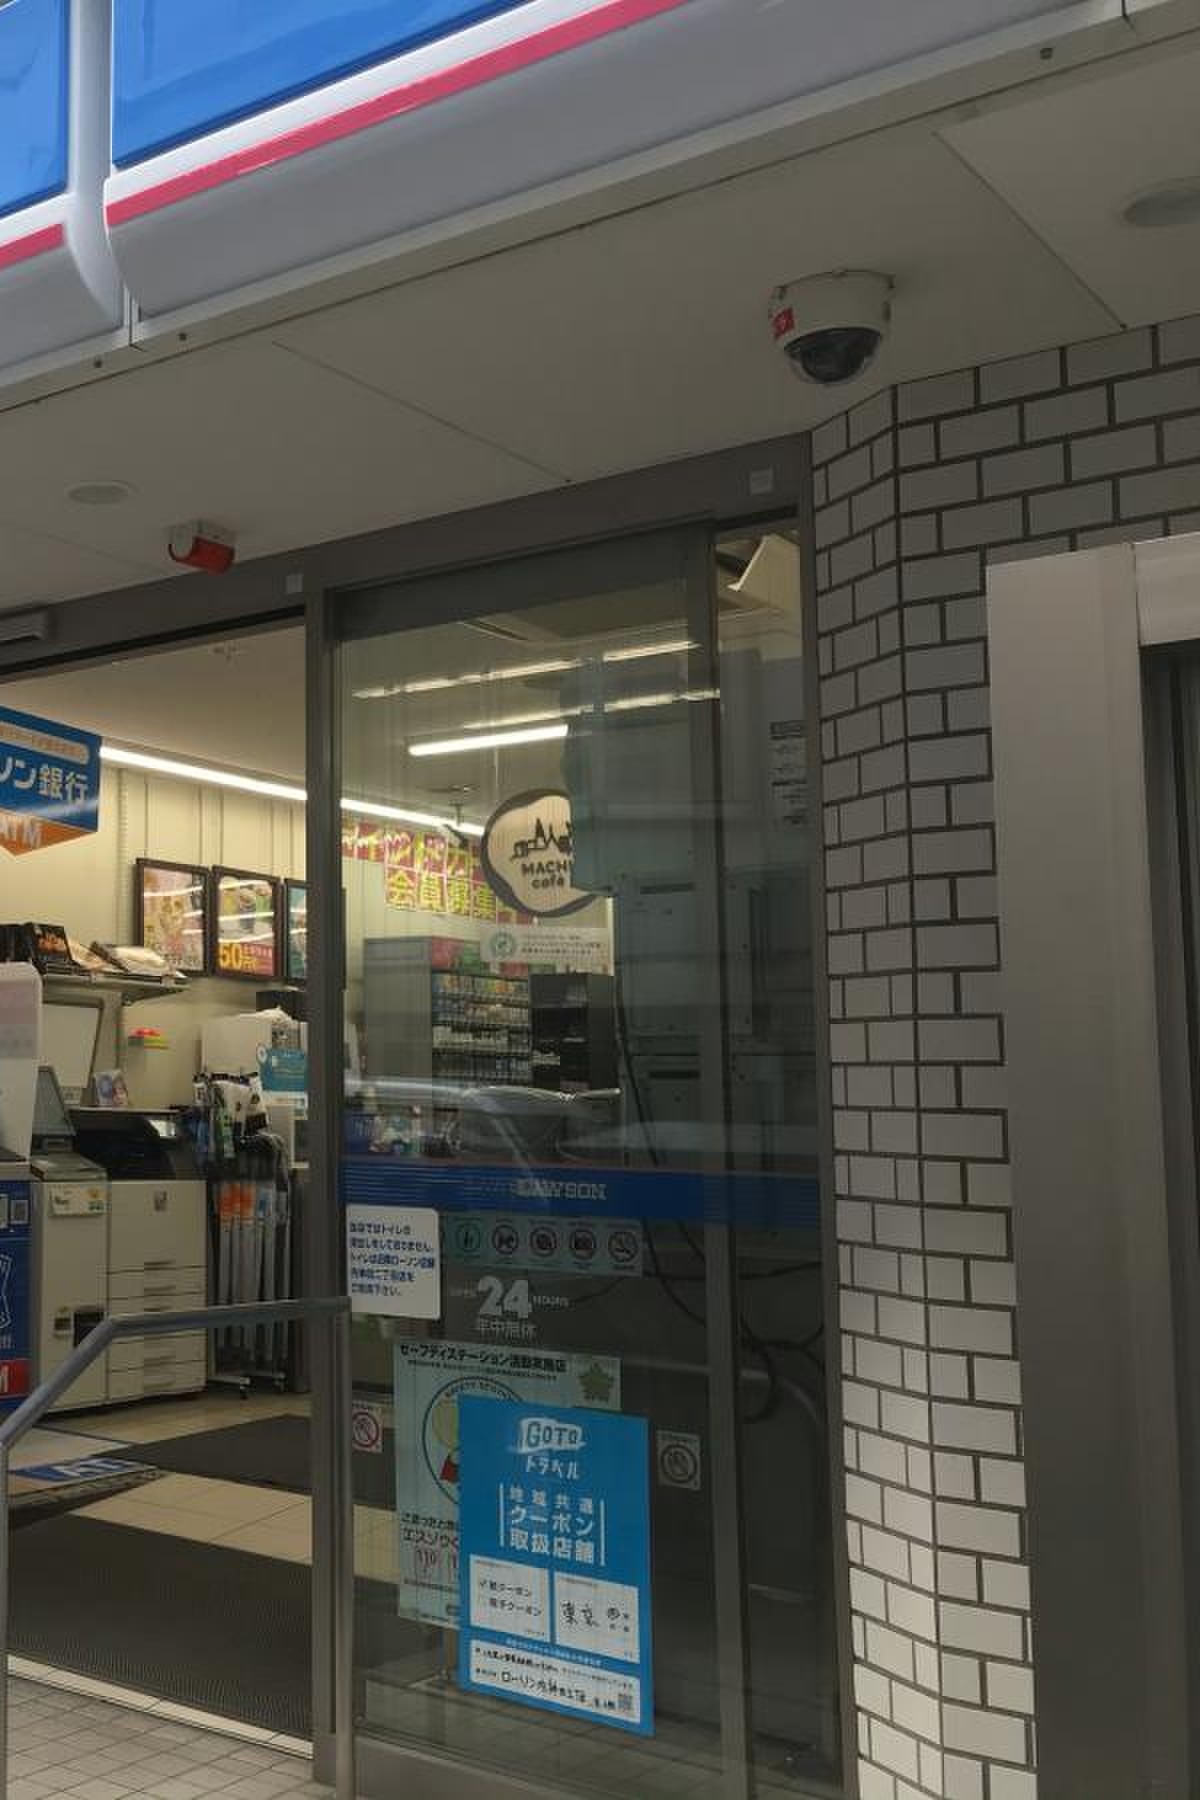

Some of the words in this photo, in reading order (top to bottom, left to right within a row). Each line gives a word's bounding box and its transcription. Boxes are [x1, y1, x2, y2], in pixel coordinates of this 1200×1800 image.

[478, 1275, 532, 1319] 24
[525, 1454, 580, 1480] トラベル
[510, 1505, 595, 1536] クーポン
[509, 1527, 596, 1565] 取扱店舗
